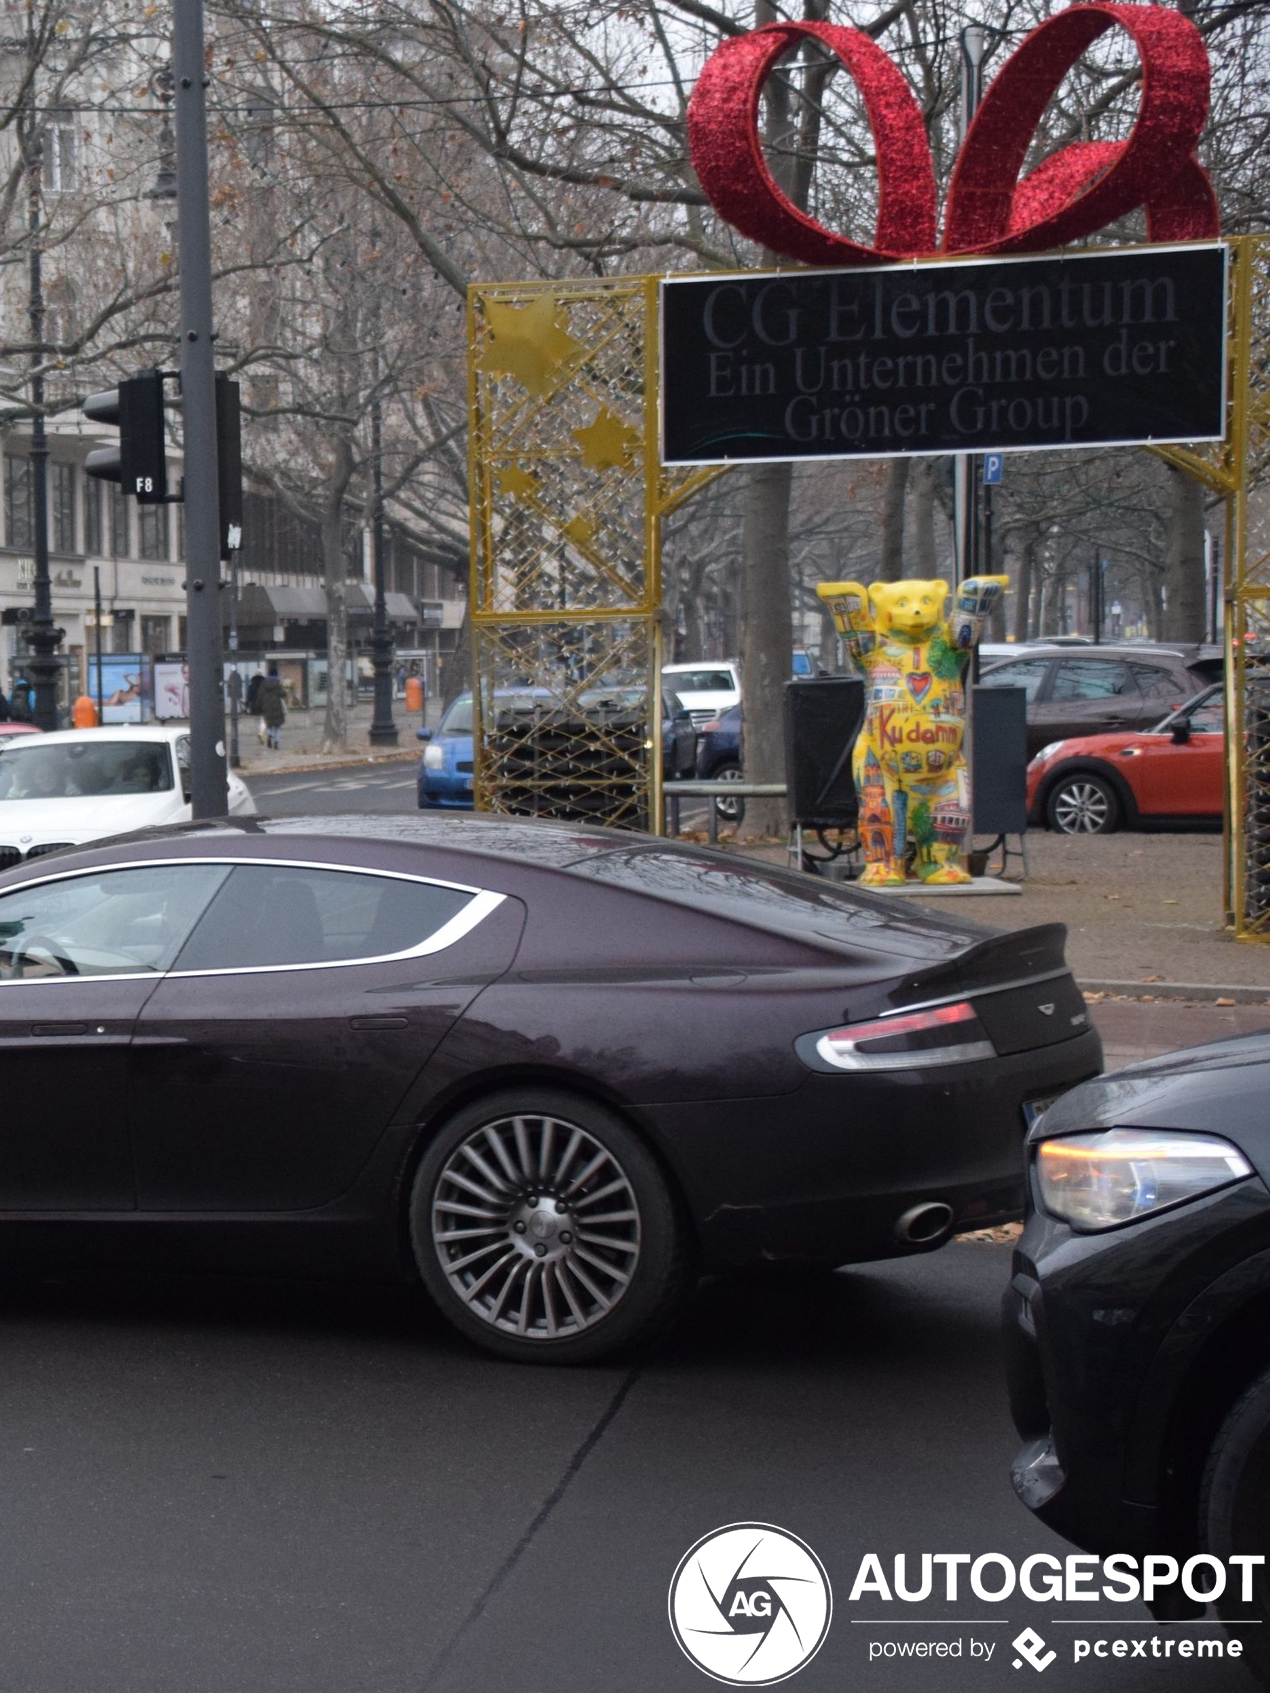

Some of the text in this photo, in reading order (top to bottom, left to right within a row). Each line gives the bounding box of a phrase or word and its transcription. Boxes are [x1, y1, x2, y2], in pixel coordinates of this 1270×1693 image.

[702, 274, 1180, 349] CG Elementum
[708, 335, 1176, 398] Ein Unternehmen der
[784, 386, 1089, 442] Gröner Group
[135, 477, 153, 493] F8
[987, 456, 999, 480] P
